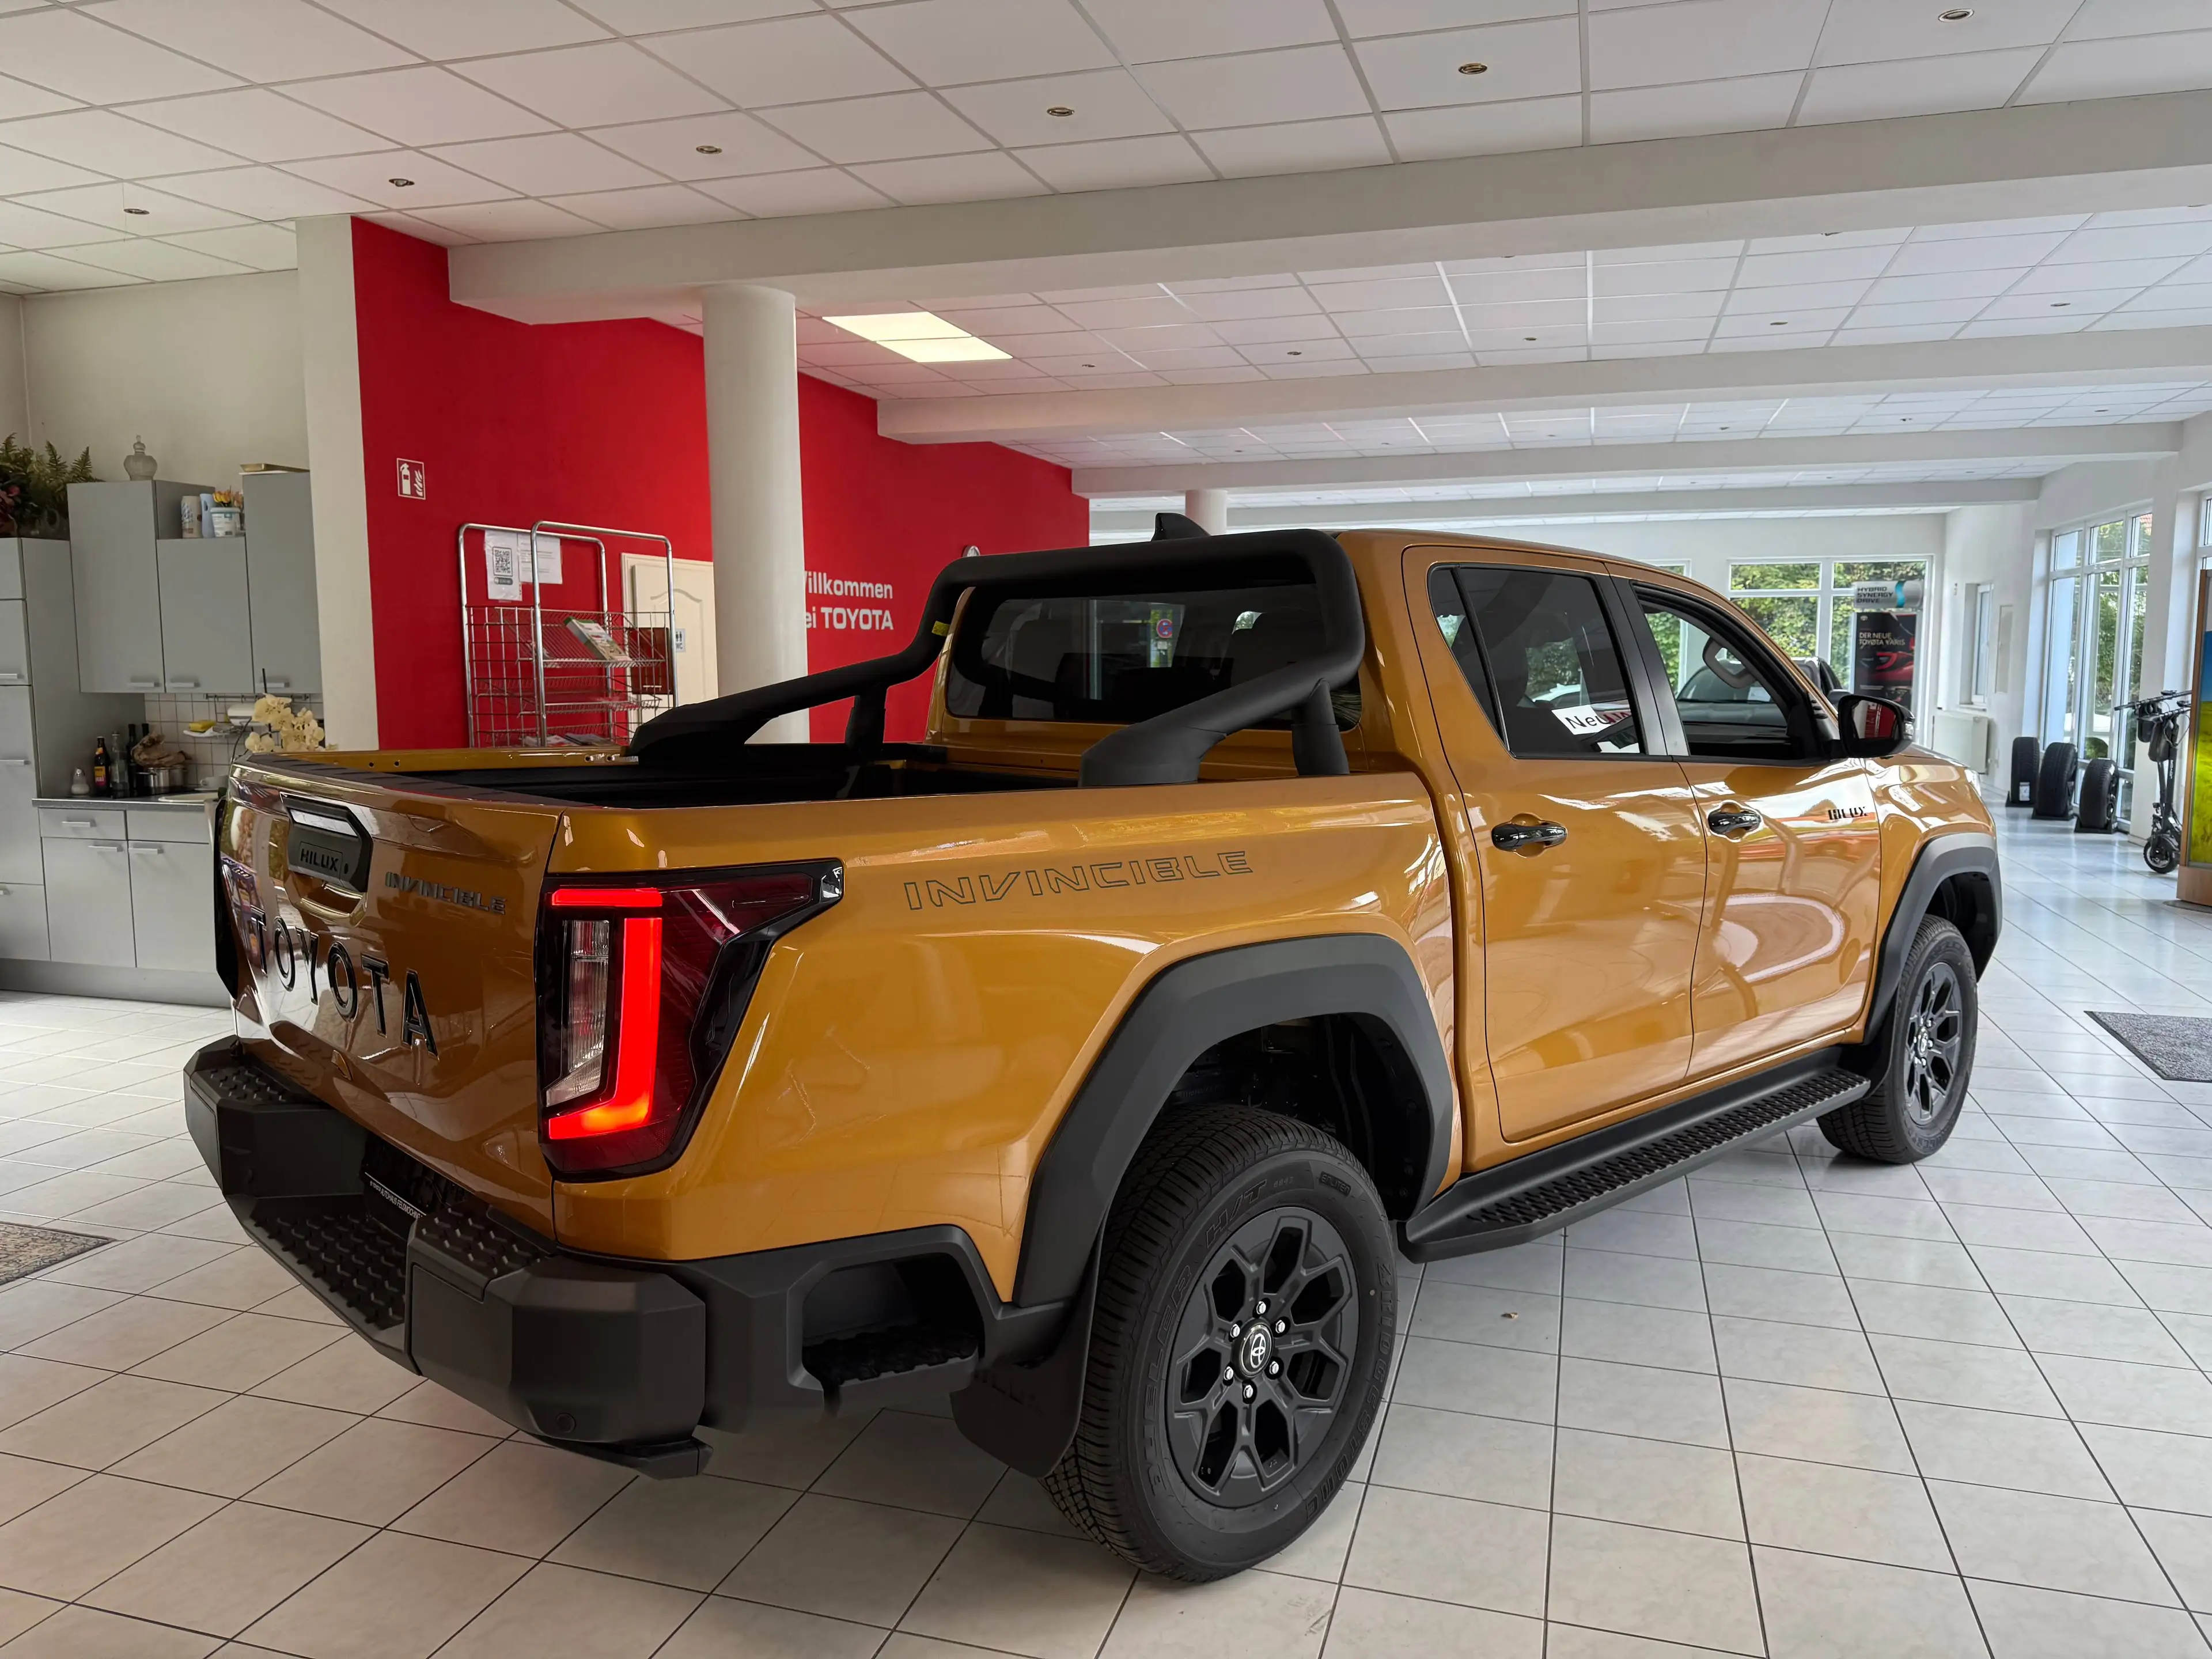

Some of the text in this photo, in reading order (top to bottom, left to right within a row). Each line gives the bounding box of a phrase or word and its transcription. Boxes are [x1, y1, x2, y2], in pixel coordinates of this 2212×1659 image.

[805, 570, 893, 599] illkommen
[805, 606, 894, 631] ei TOYOTA
[1828, 806, 1868, 820] HILUX
[299, 848, 340, 873] HILUX
[384, 871, 507, 915] INVINCIBLE
[903, 850, 1253, 911] INVINCIBLE
[250, 905, 440, 1060] TOYOTA
[380, 1188, 397, 1205] AUTOHAUS
[1205, 1178, 1268, 1249] H/T
[1305, 1260, 1393, 1522] BRIDGESTONE
